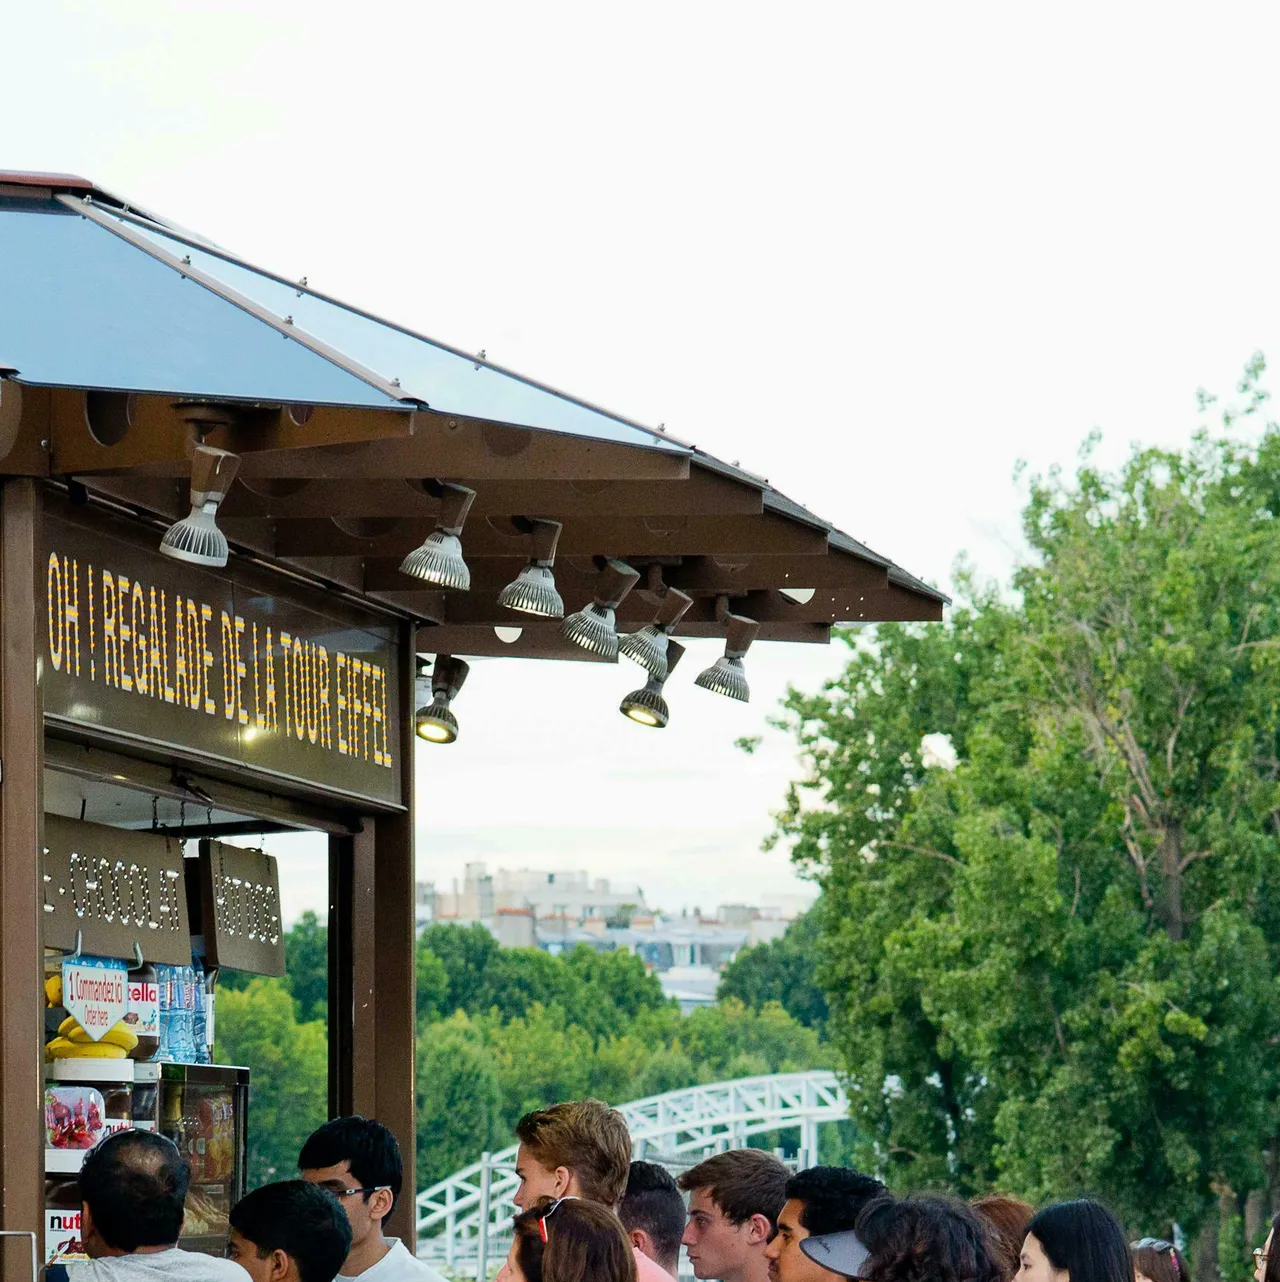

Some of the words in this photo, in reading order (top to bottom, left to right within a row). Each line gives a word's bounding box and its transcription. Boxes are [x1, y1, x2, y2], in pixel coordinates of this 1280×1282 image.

[47, 552, 80, 678] OH
[102, 569, 217, 716] REGALADE
[221, 610, 250, 725] DE
[252, 621, 278, 734] LA
[280, 630, 333, 750] TOUR
[336, 651, 393, 769] EIFFEL
[68, 971, 75, 1001] 1
[75, 971, 114, 1004] Commandez
[83, 1004, 97, 1026] Order
[98, 1007, 108, 1027] here
